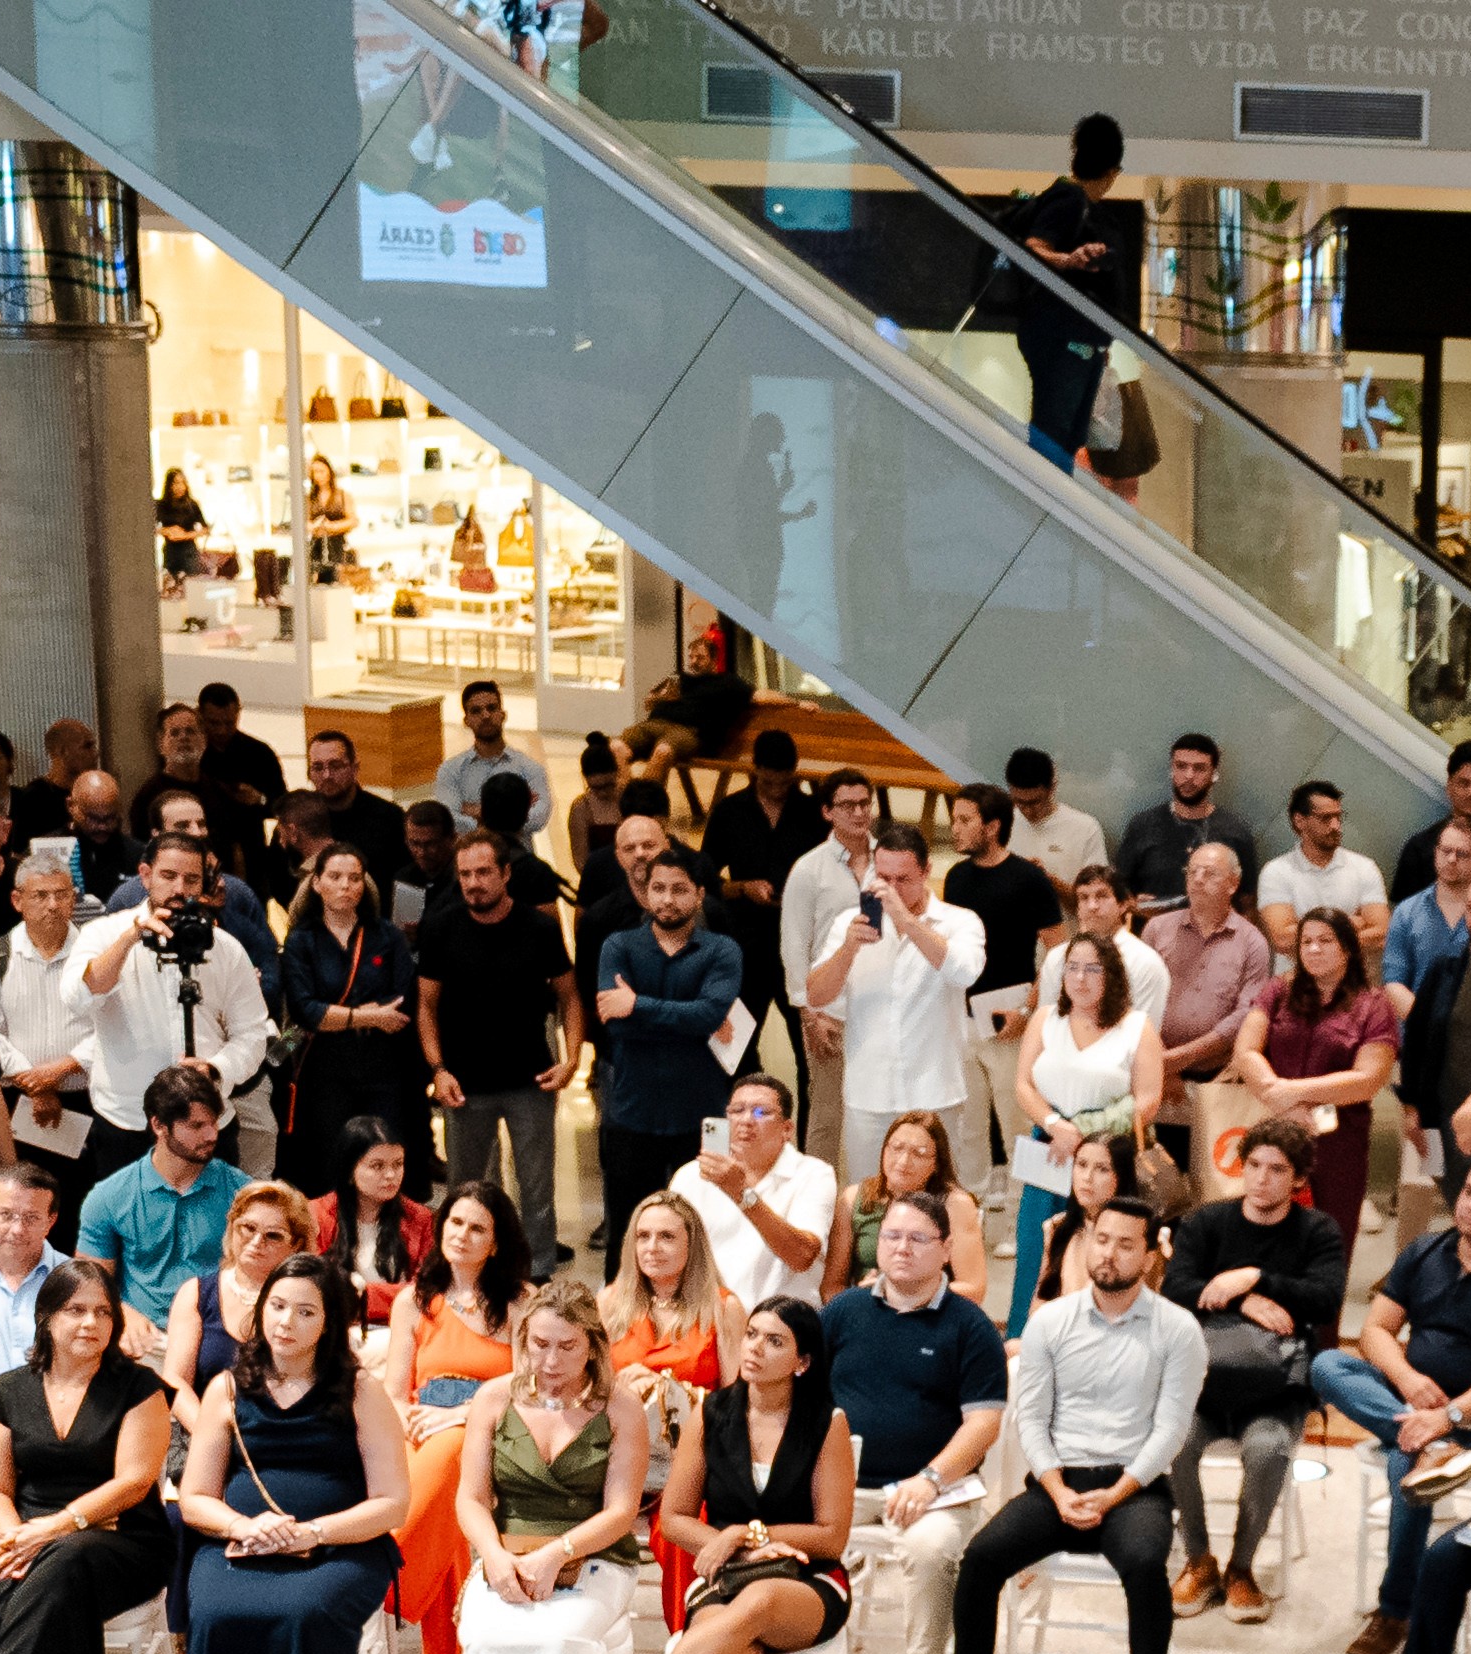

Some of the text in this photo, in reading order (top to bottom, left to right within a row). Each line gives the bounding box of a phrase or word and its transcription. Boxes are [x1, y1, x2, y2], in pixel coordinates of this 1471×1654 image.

[1302, 7, 1367, 38] PAZ
[821, 22, 956, 59] KÄRLEK
[986, 32, 1165, 65] FRAMSTEG
[1190, 39, 1280, 69] VIDA
